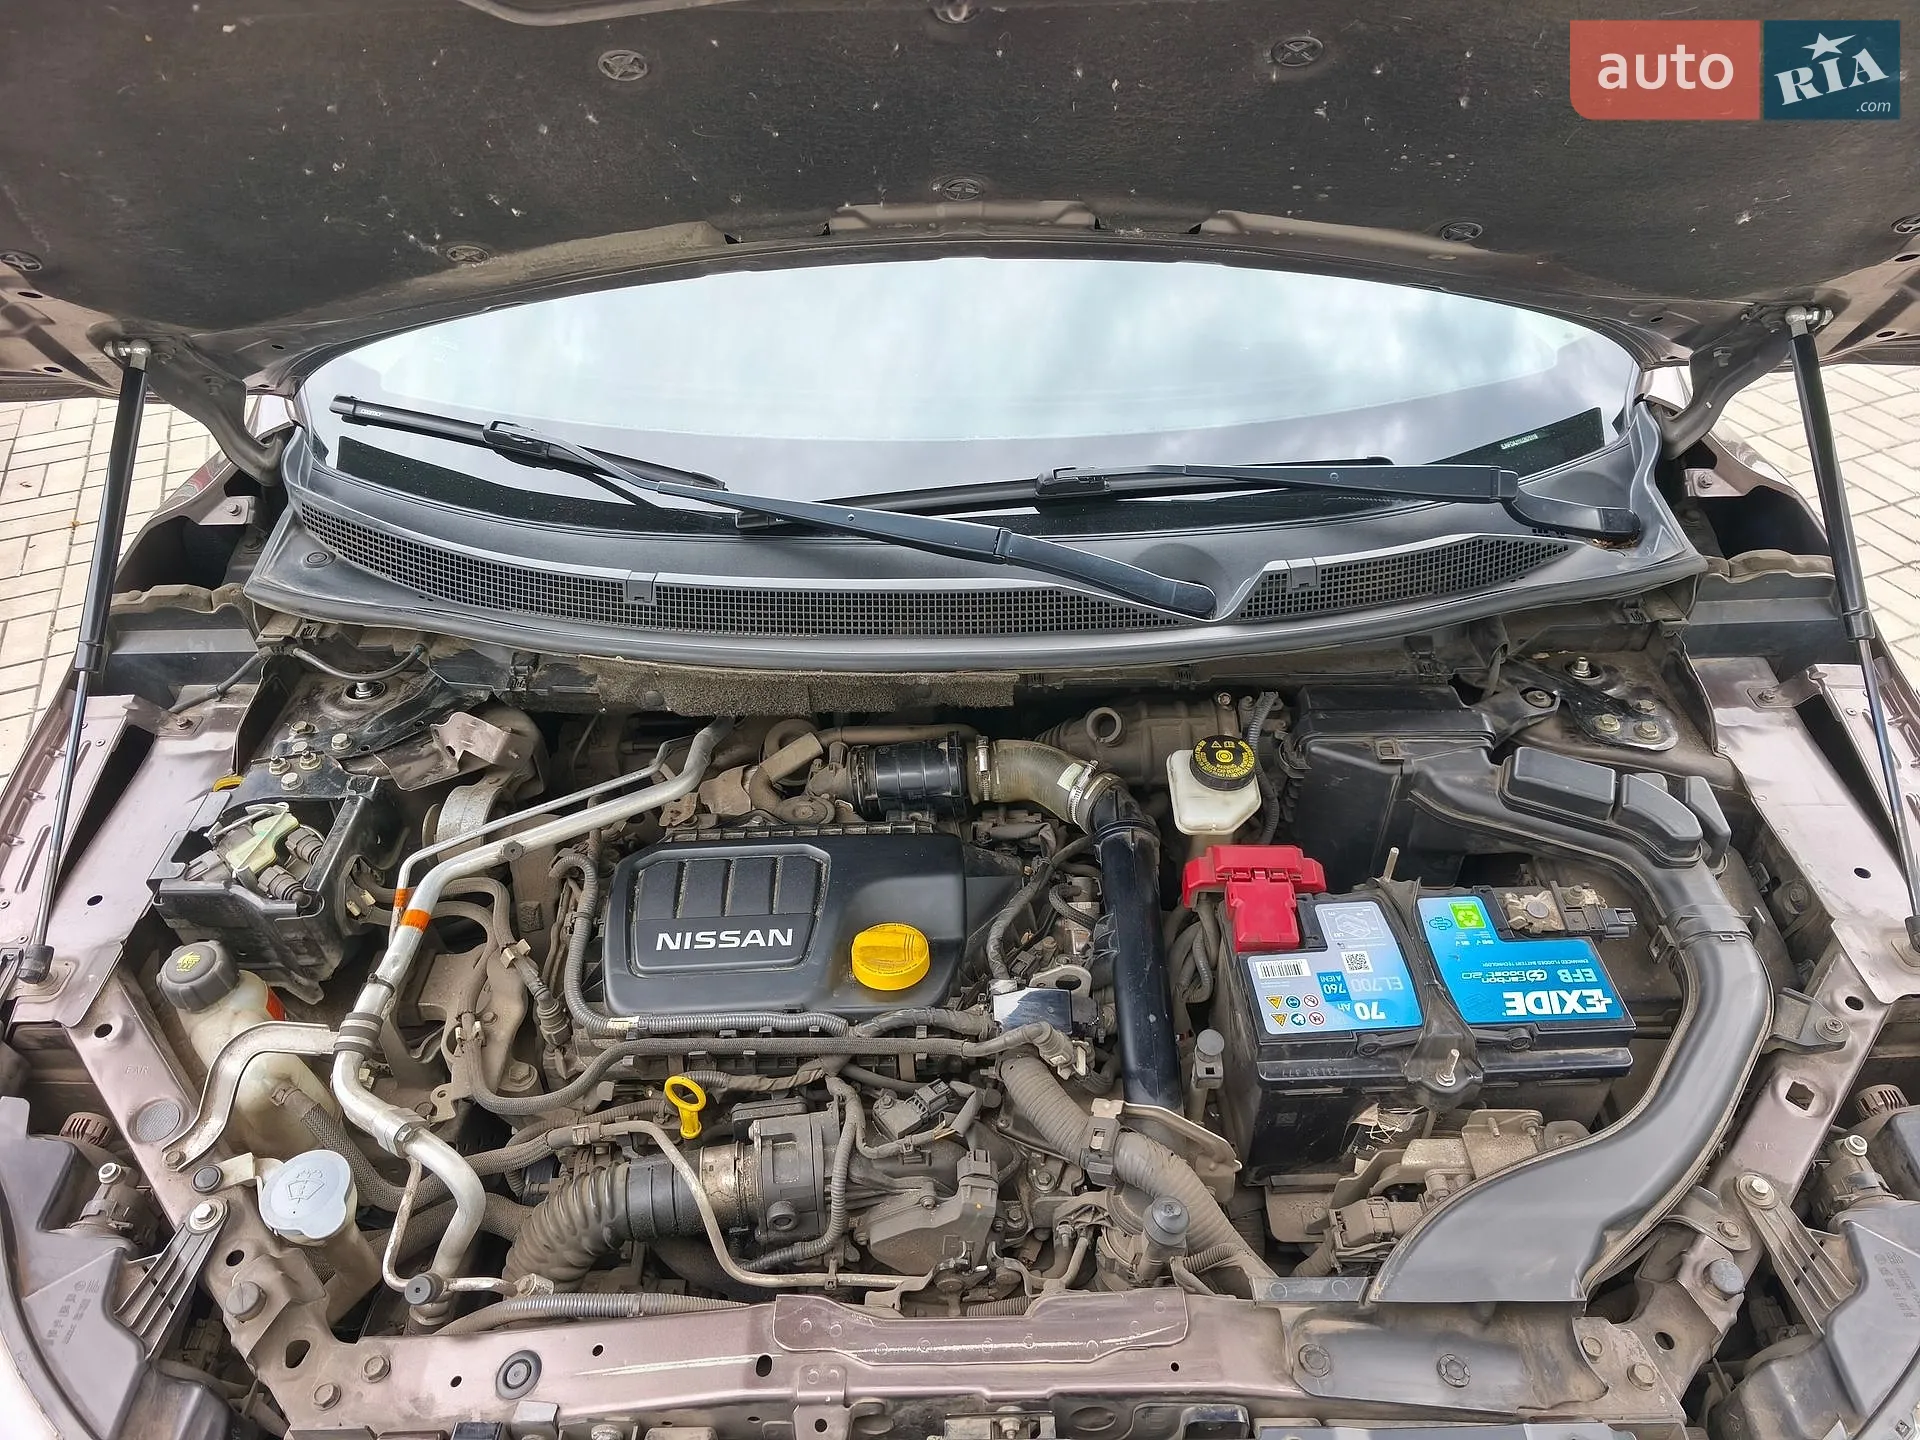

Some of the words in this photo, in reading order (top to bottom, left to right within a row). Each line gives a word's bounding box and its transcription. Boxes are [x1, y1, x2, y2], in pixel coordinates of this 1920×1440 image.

[656, 928, 793, 951] NISSAN
[1557, 968, 1598, 983] EFB
[1323, 983, 1347, 994] 760
[1351, 976, 1404, 992] EL700
[1337, 1003, 1351, 1012] Ah
[1354, 1001, 1386, 1020] 70
[1503, 989, 1612, 1016] EXIDE
